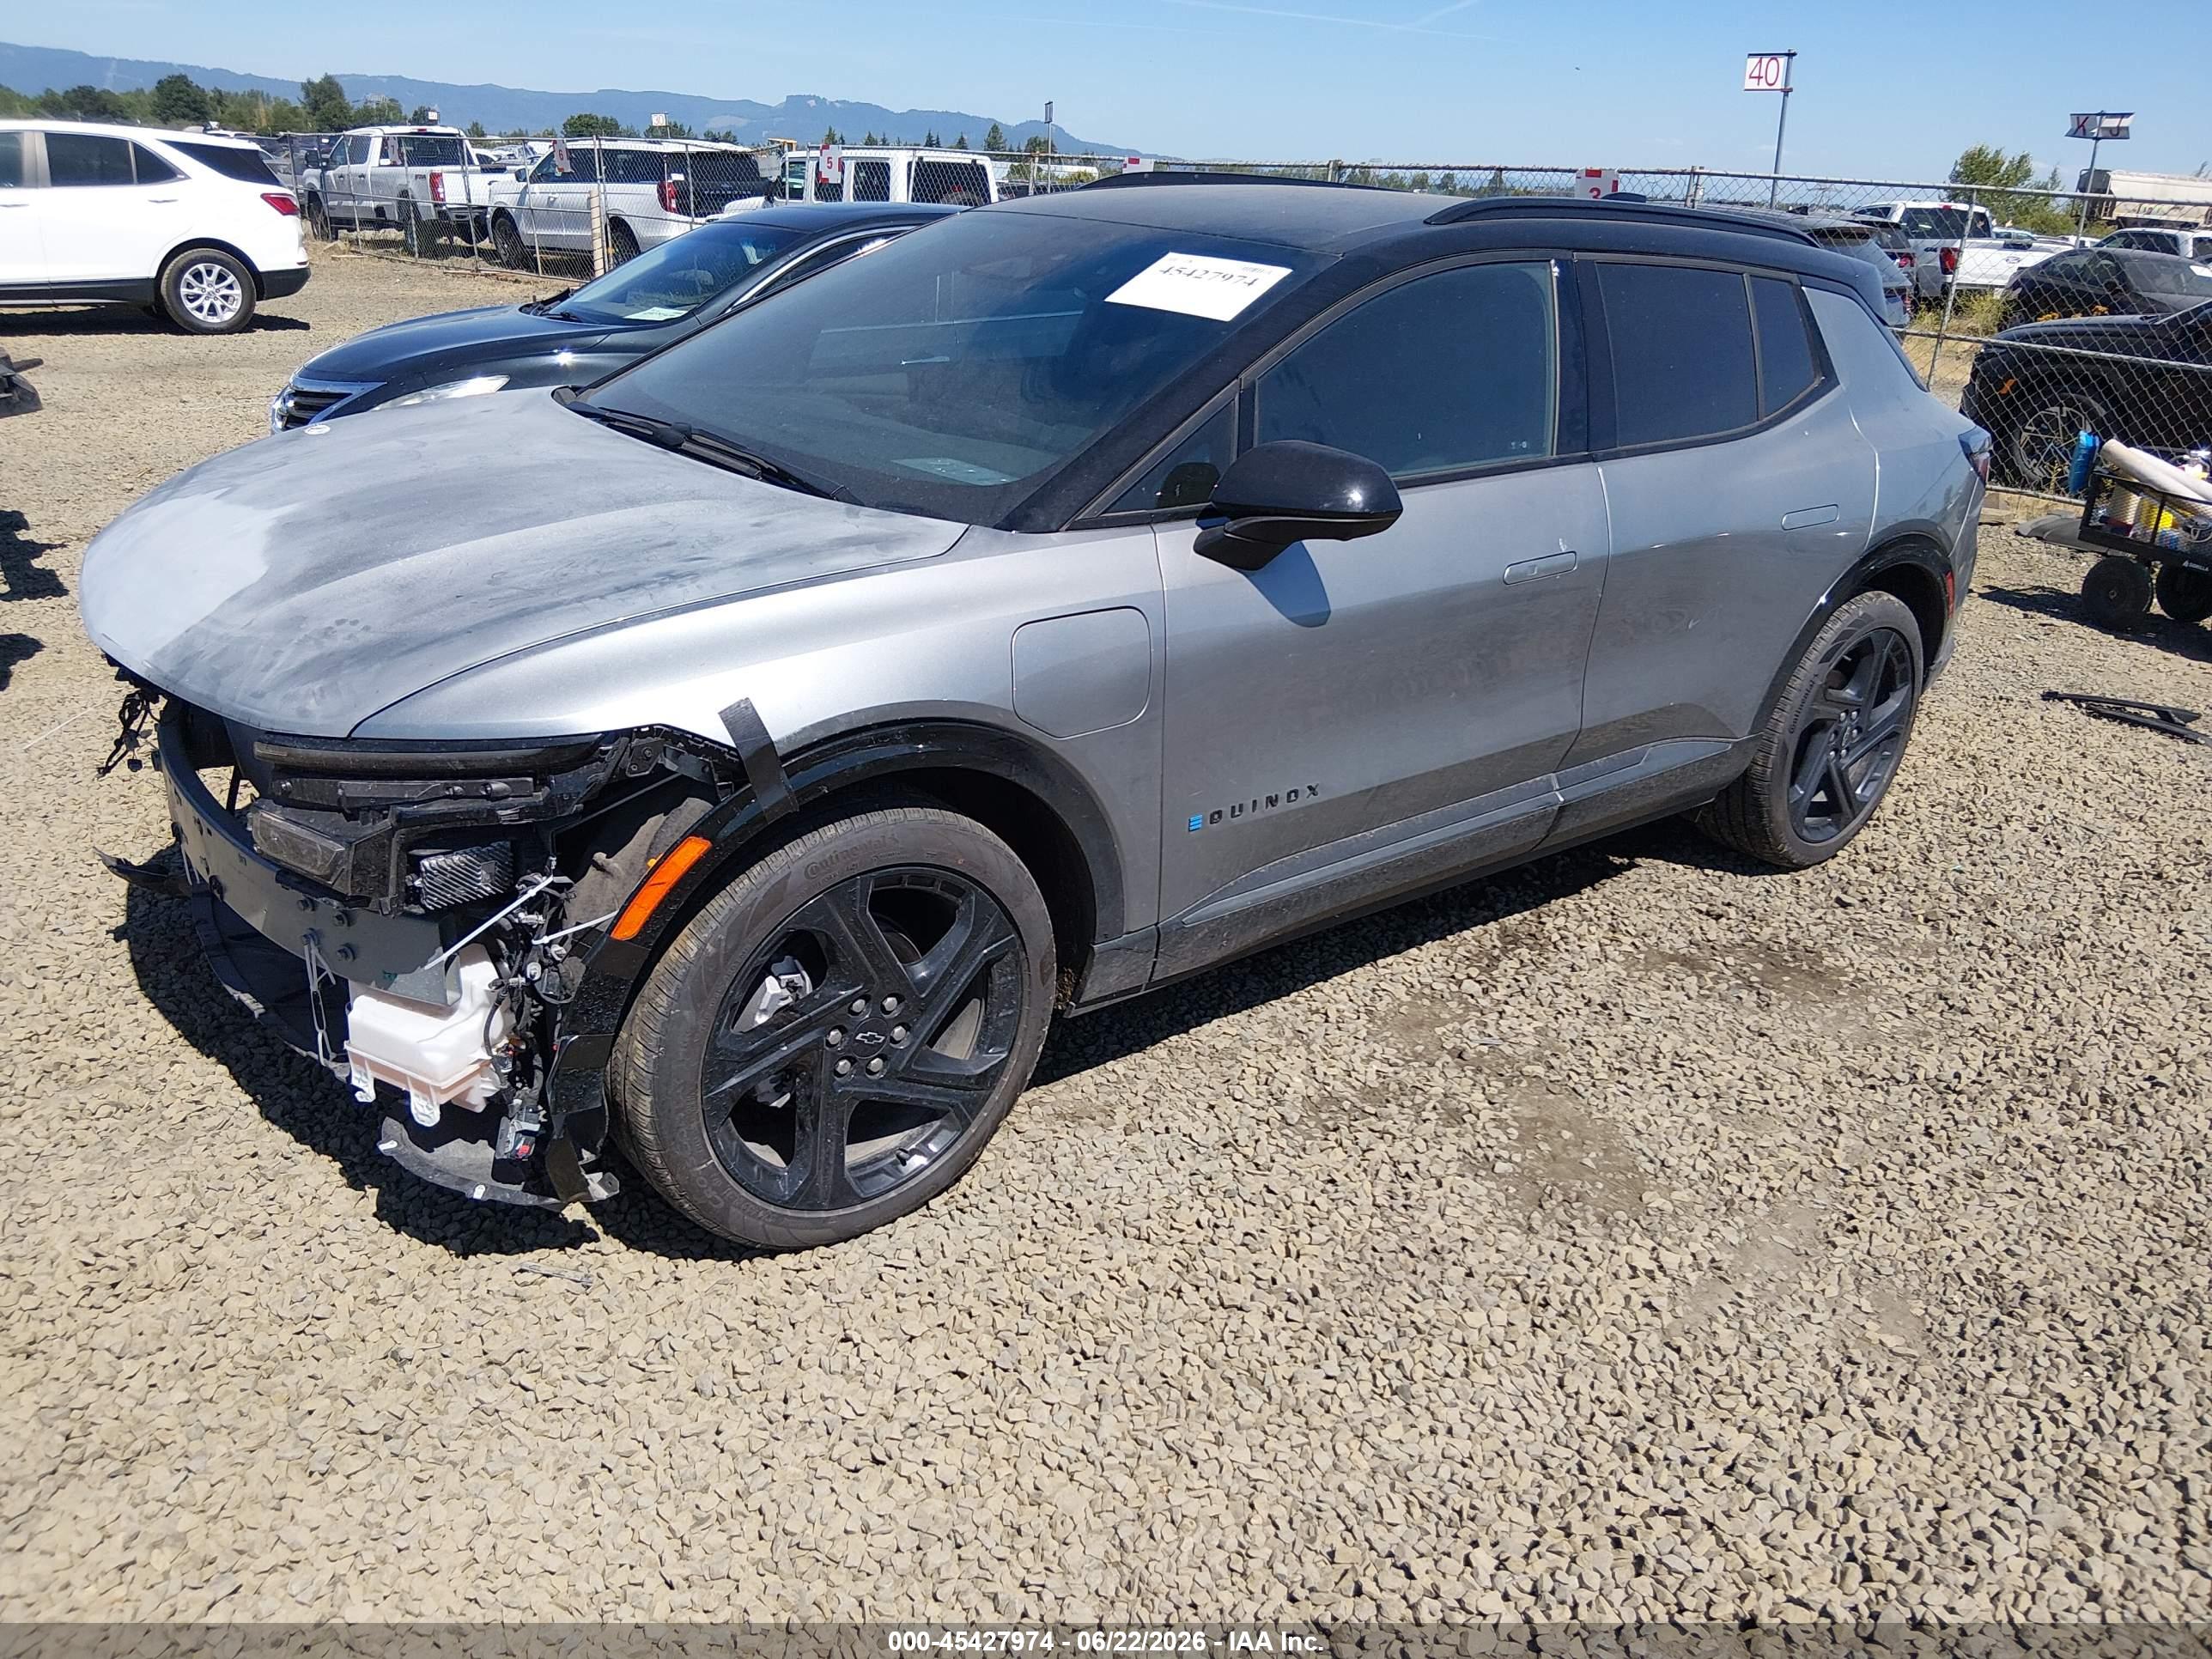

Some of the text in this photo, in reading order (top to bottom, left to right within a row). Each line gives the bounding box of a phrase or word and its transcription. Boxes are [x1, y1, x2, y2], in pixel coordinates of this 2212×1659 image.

[1748, 57, 1780, 87] 40
[2073, 116, 2089, 136] K
[2109, 115, 2124, 137] J
[558, 149, 564, 161] 6
[826, 156, 833, 169] 5
[1159, 264, 1260, 287] 45427974
[1188, 783, 1320, 832] EQUINOX
